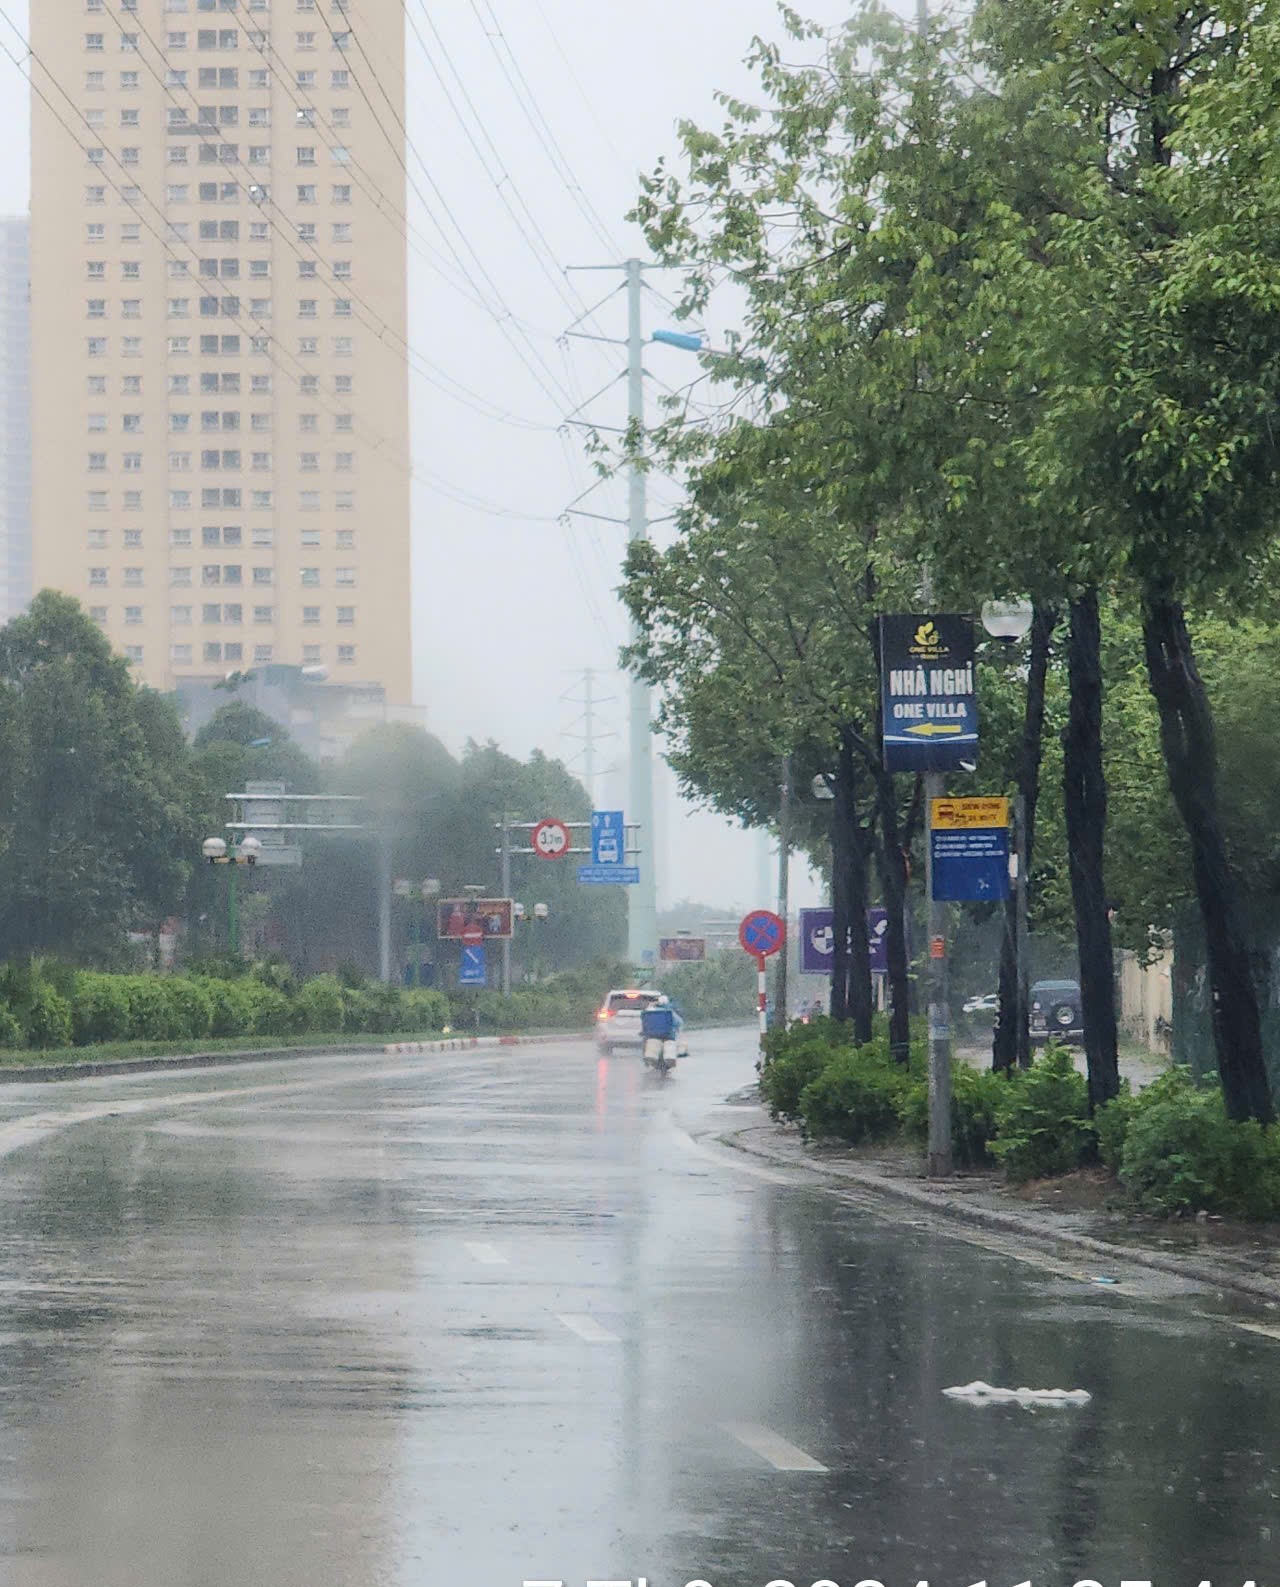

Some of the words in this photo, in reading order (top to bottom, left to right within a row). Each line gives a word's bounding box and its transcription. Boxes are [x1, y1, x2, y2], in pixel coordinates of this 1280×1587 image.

[890, 664, 927, 696] NHÀ
[930, 660, 973, 695] NGHỈ
[893, 703, 924, 718] ONE
[926, 702, 968, 717] VILLA
